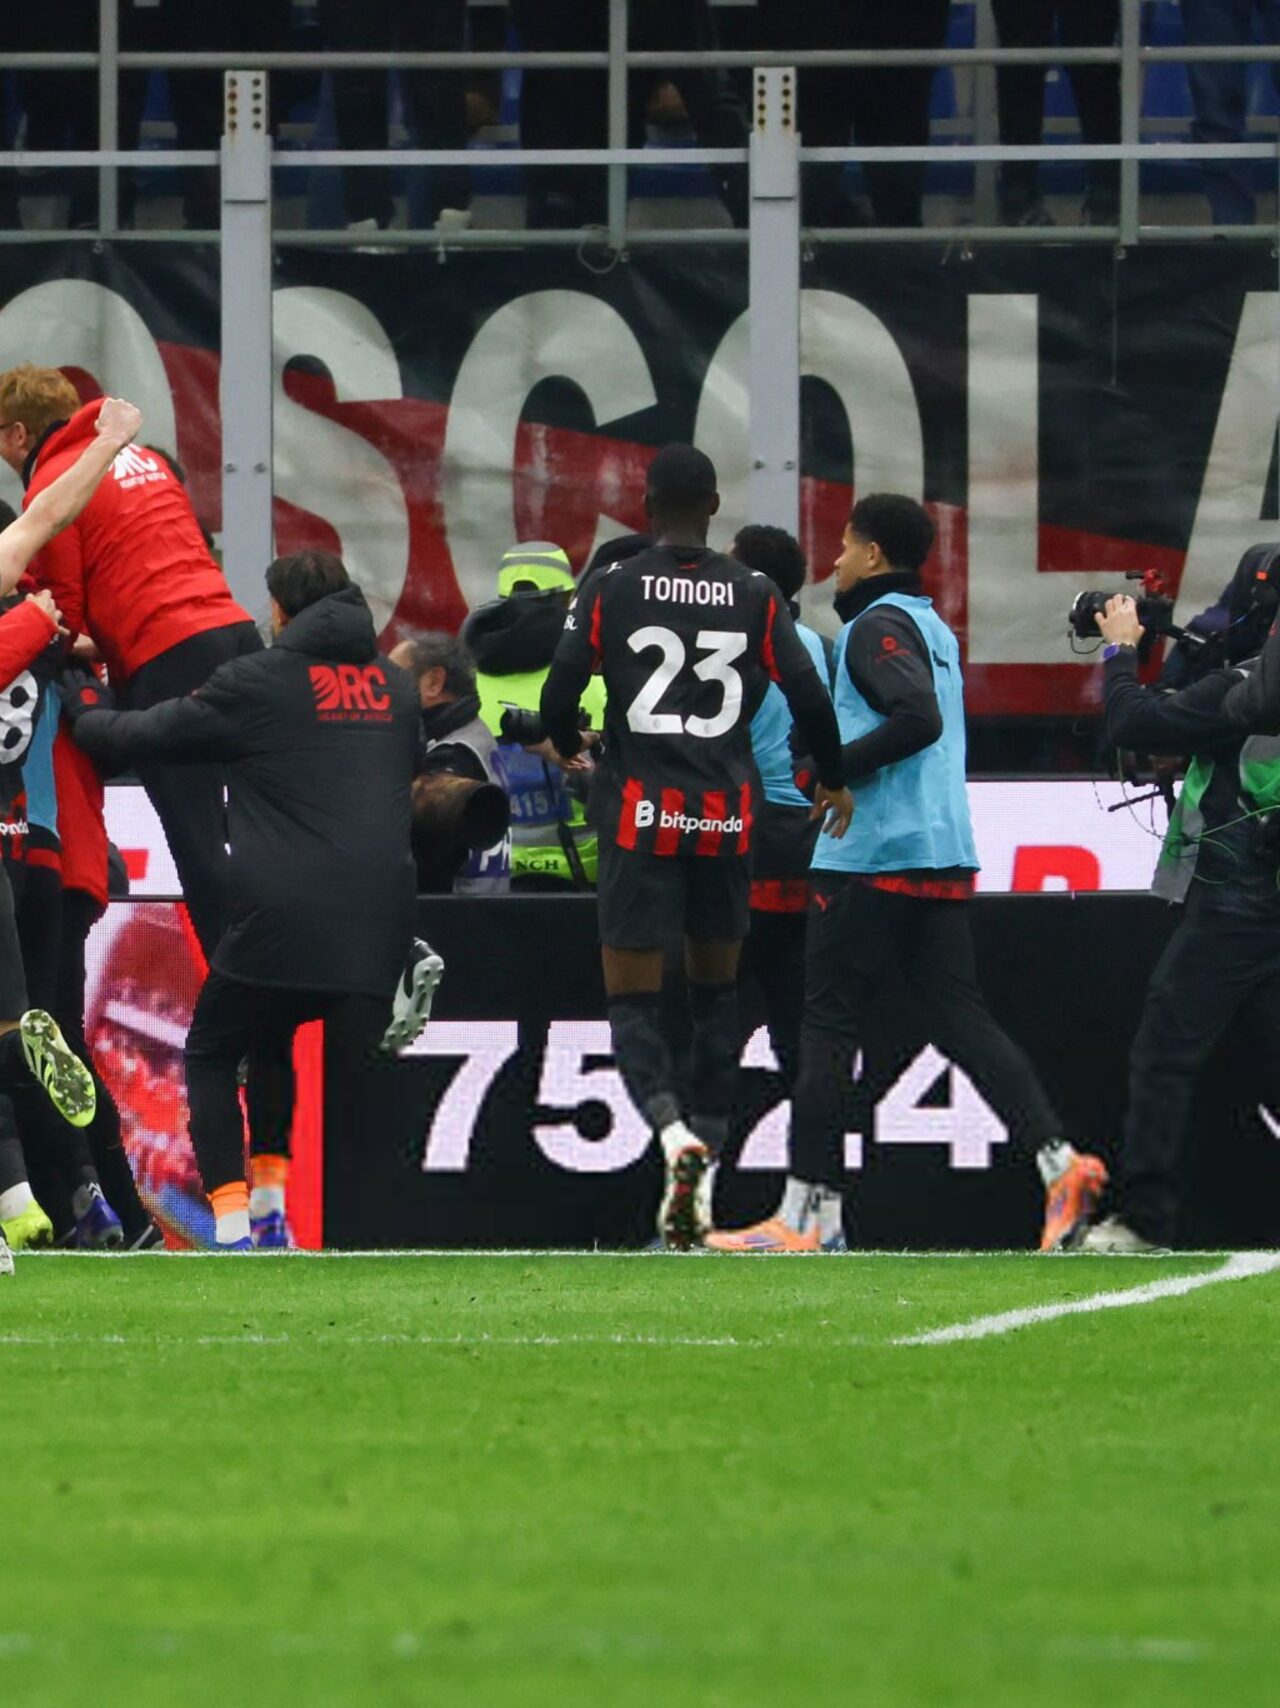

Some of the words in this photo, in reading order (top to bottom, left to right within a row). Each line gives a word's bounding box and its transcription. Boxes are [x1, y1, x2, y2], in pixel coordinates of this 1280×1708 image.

[641, 575, 734, 606] TOMORI
[308, 664, 391, 710] DRC
[626, 625, 747, 738] 23
[660, 809, 743, 834] bitpanda
